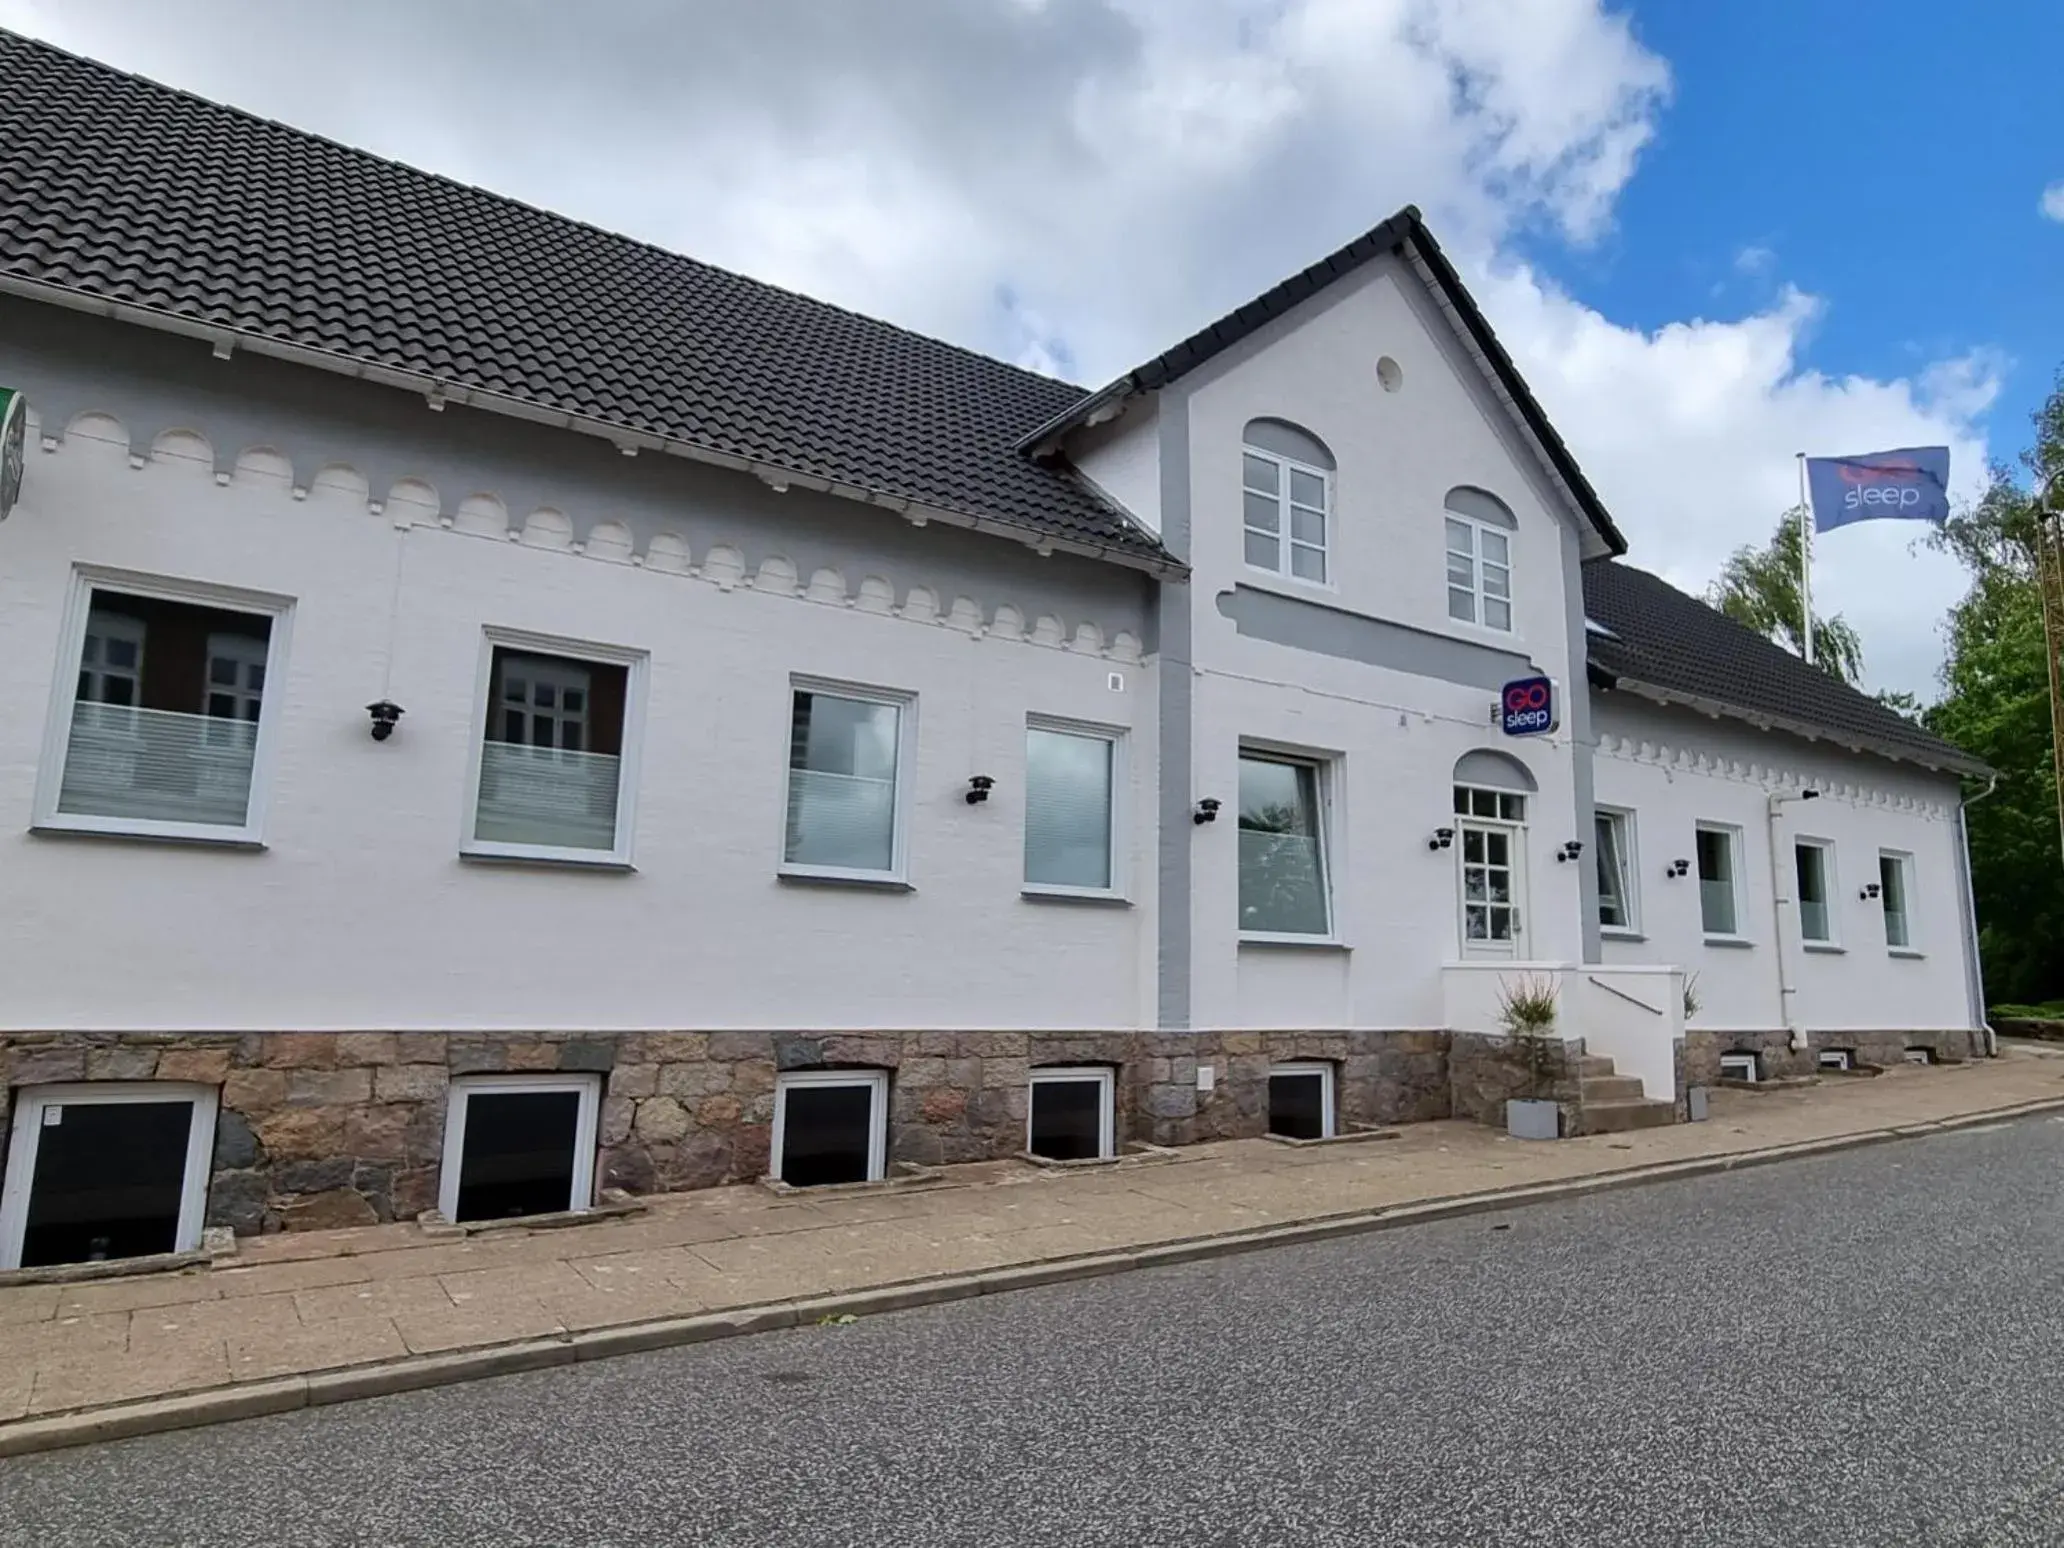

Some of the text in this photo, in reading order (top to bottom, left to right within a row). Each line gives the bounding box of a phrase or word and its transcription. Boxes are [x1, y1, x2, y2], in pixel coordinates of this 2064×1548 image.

[1844, 483, 1920, 510] sleep
[1507, 684, 1547, 710] GO
[1507, 709, 1548, 728] sleep
